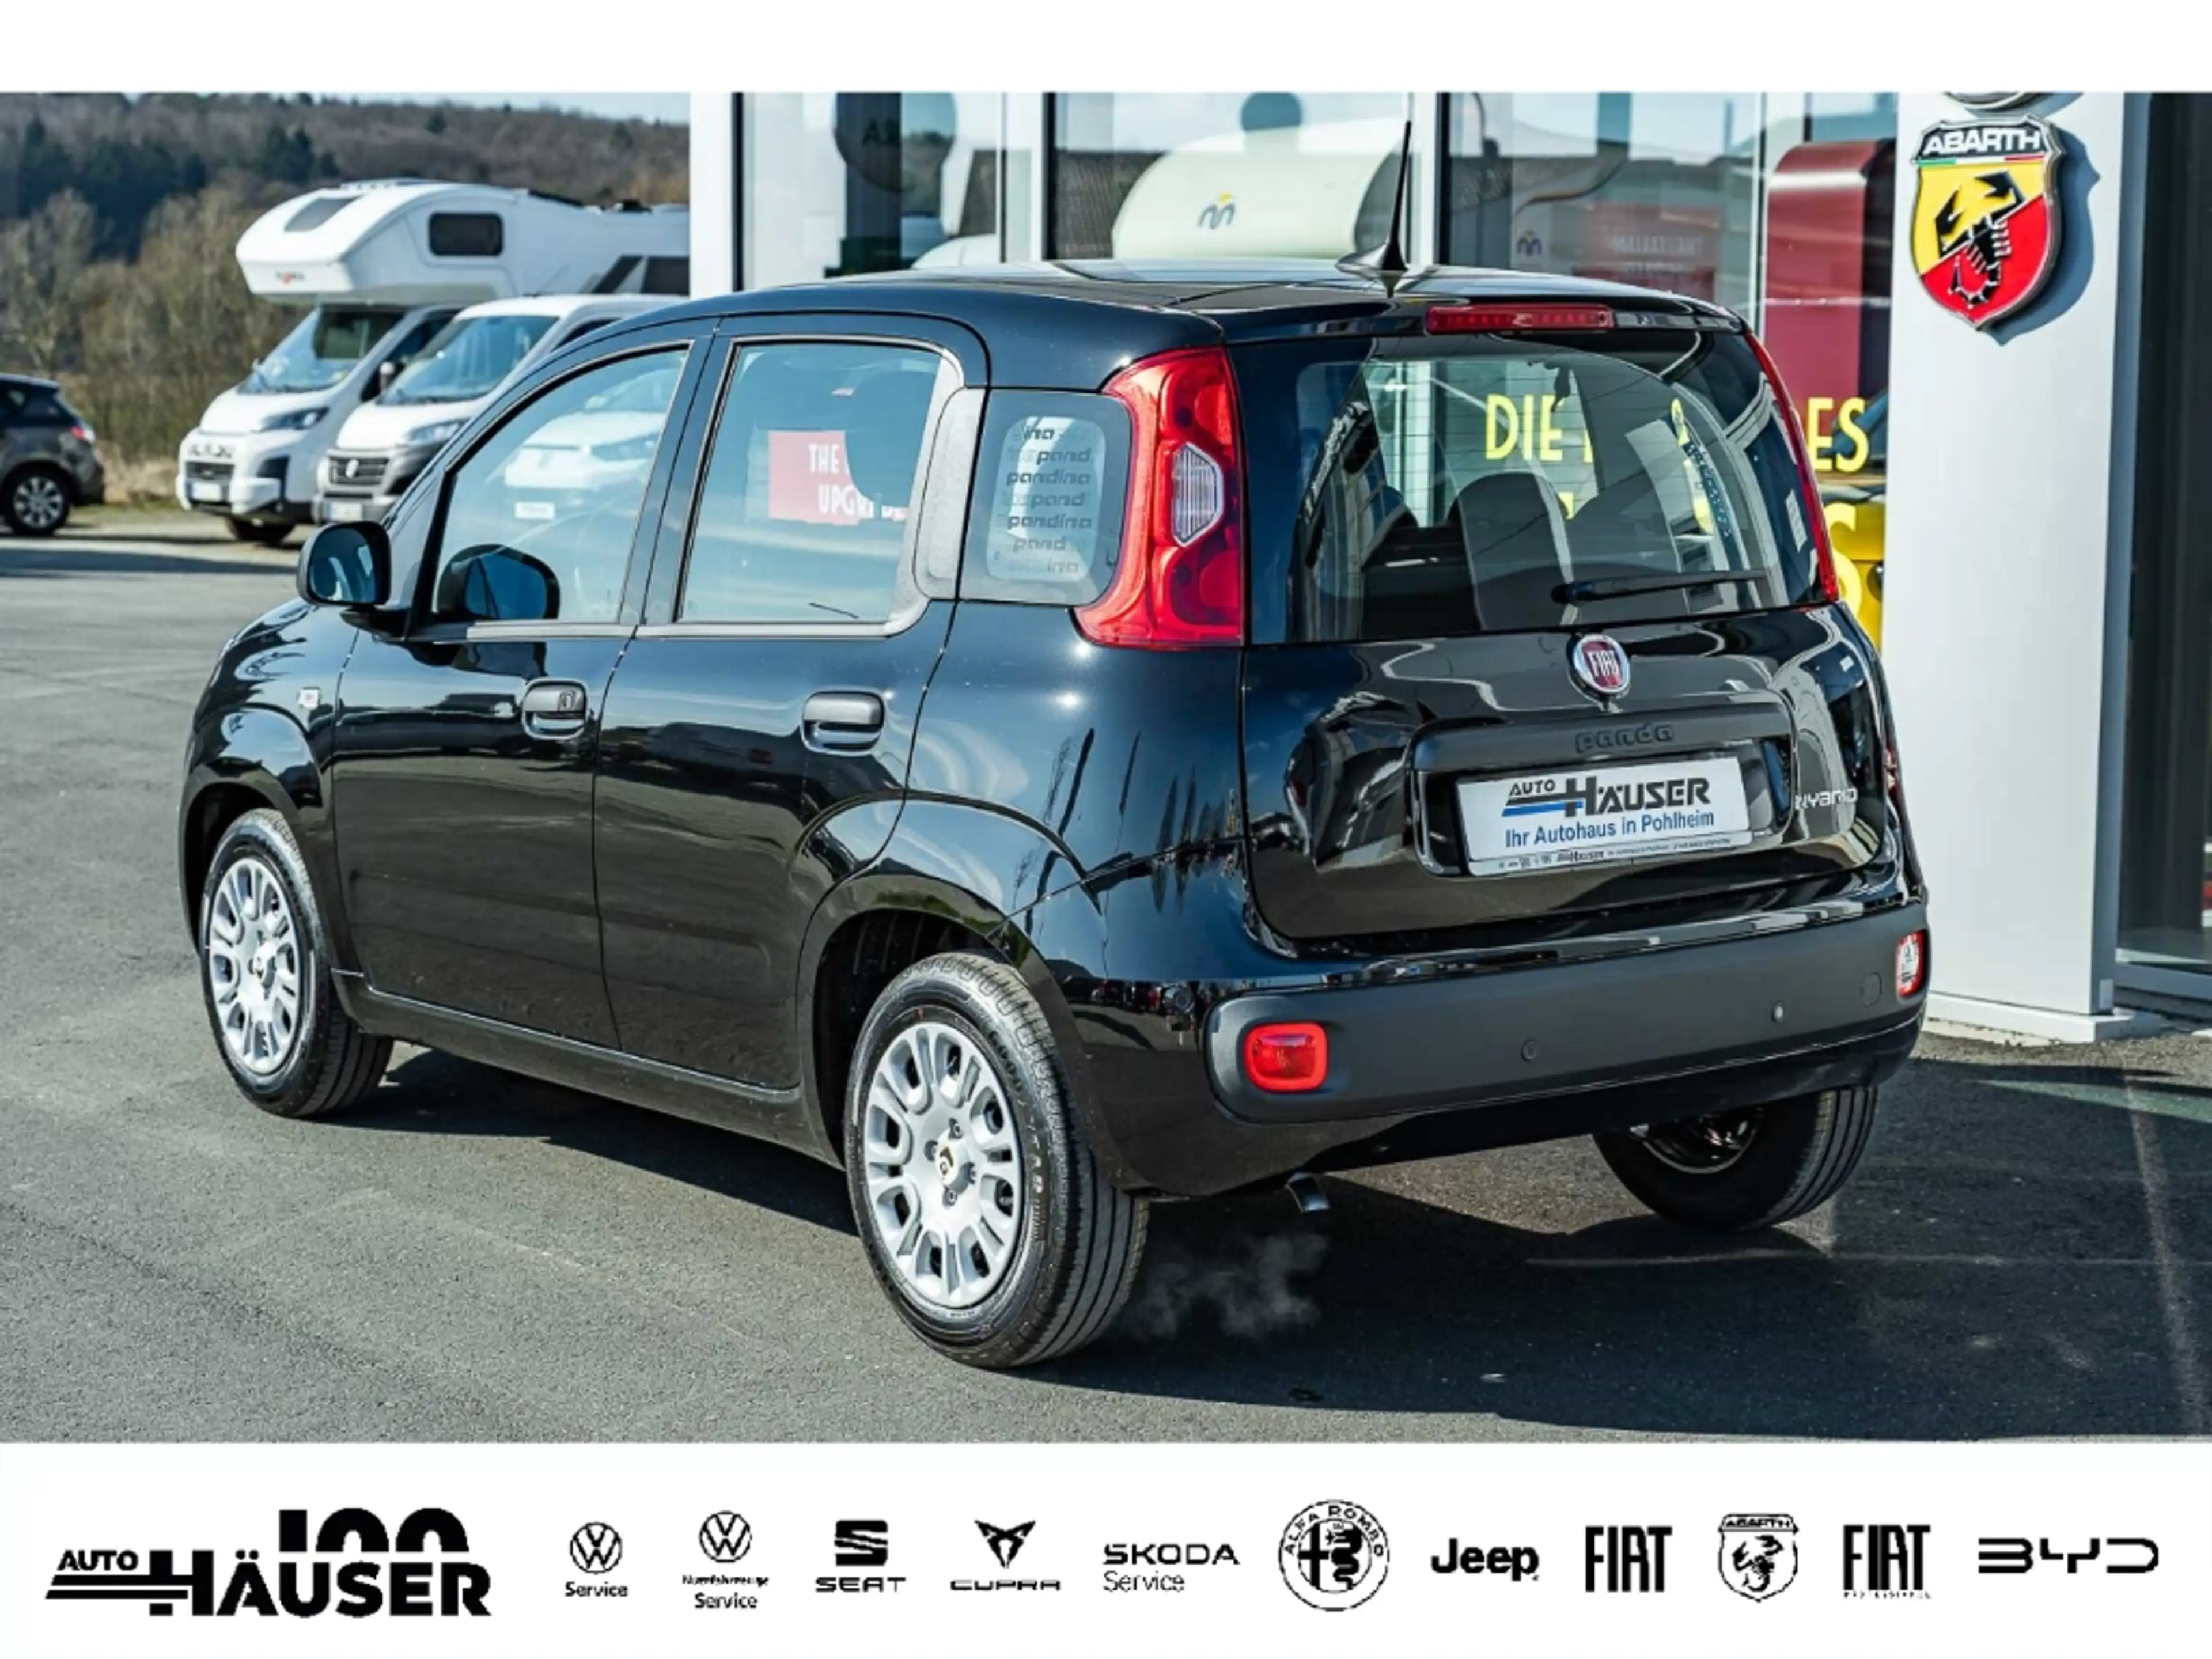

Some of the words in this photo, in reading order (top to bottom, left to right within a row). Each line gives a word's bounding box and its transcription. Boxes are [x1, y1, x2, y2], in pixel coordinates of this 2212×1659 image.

[1923, 127, 2041, 156] ABARTH
[807, 443, 840, 474] THE
[1588, 649, 1619, 677] FIAT
[1509, 779, 1556, 797] AUTO
[1564, 775, 1711, 817] HÄUSER
[1505, 828, 1529, 848] Ihr
[1533, 821, 1617, 845] Autohaus
[1621, 816, 1637, 835] in
[1641, 809, 1714, 832] Pohlheim
